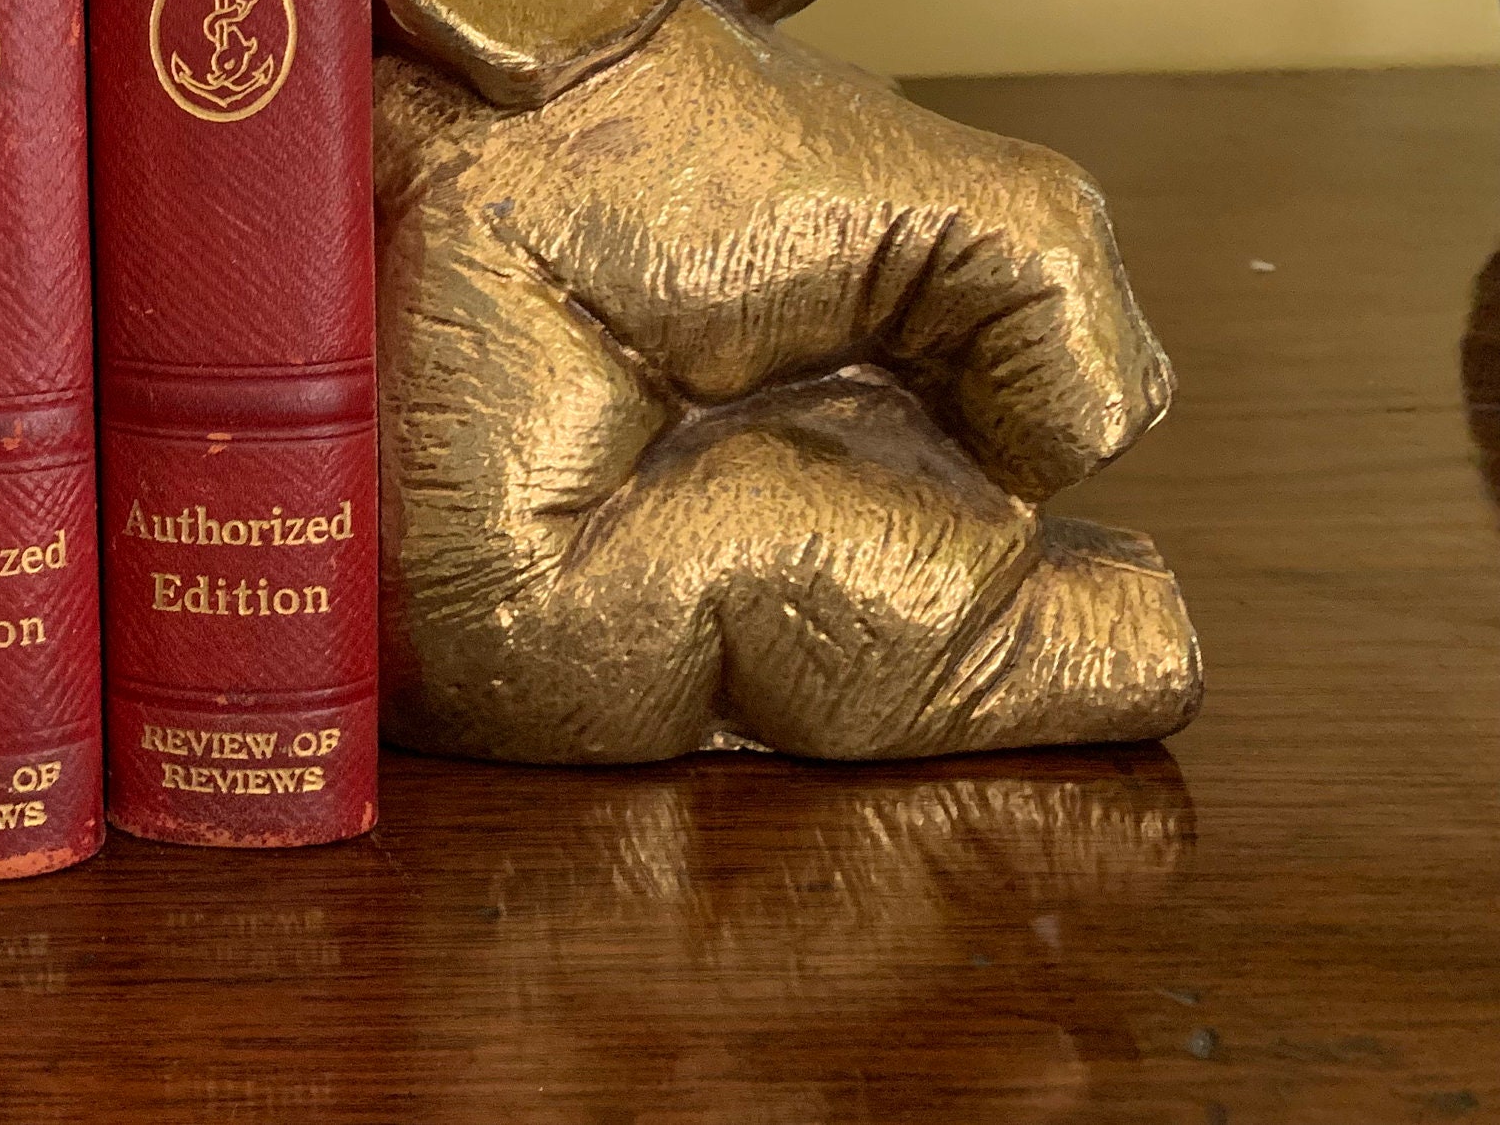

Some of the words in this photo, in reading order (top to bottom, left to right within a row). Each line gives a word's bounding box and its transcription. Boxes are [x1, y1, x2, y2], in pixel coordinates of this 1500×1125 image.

[122, 499, 355, 548] Authorized
[150, 572, 331, 617] Edition
[141, 724, 279, 761] REVIEW
[292, 727, 342, 758] OF
[11, 760, 63, 794] OF
[161, 763, 326, 796] REVIEWS
